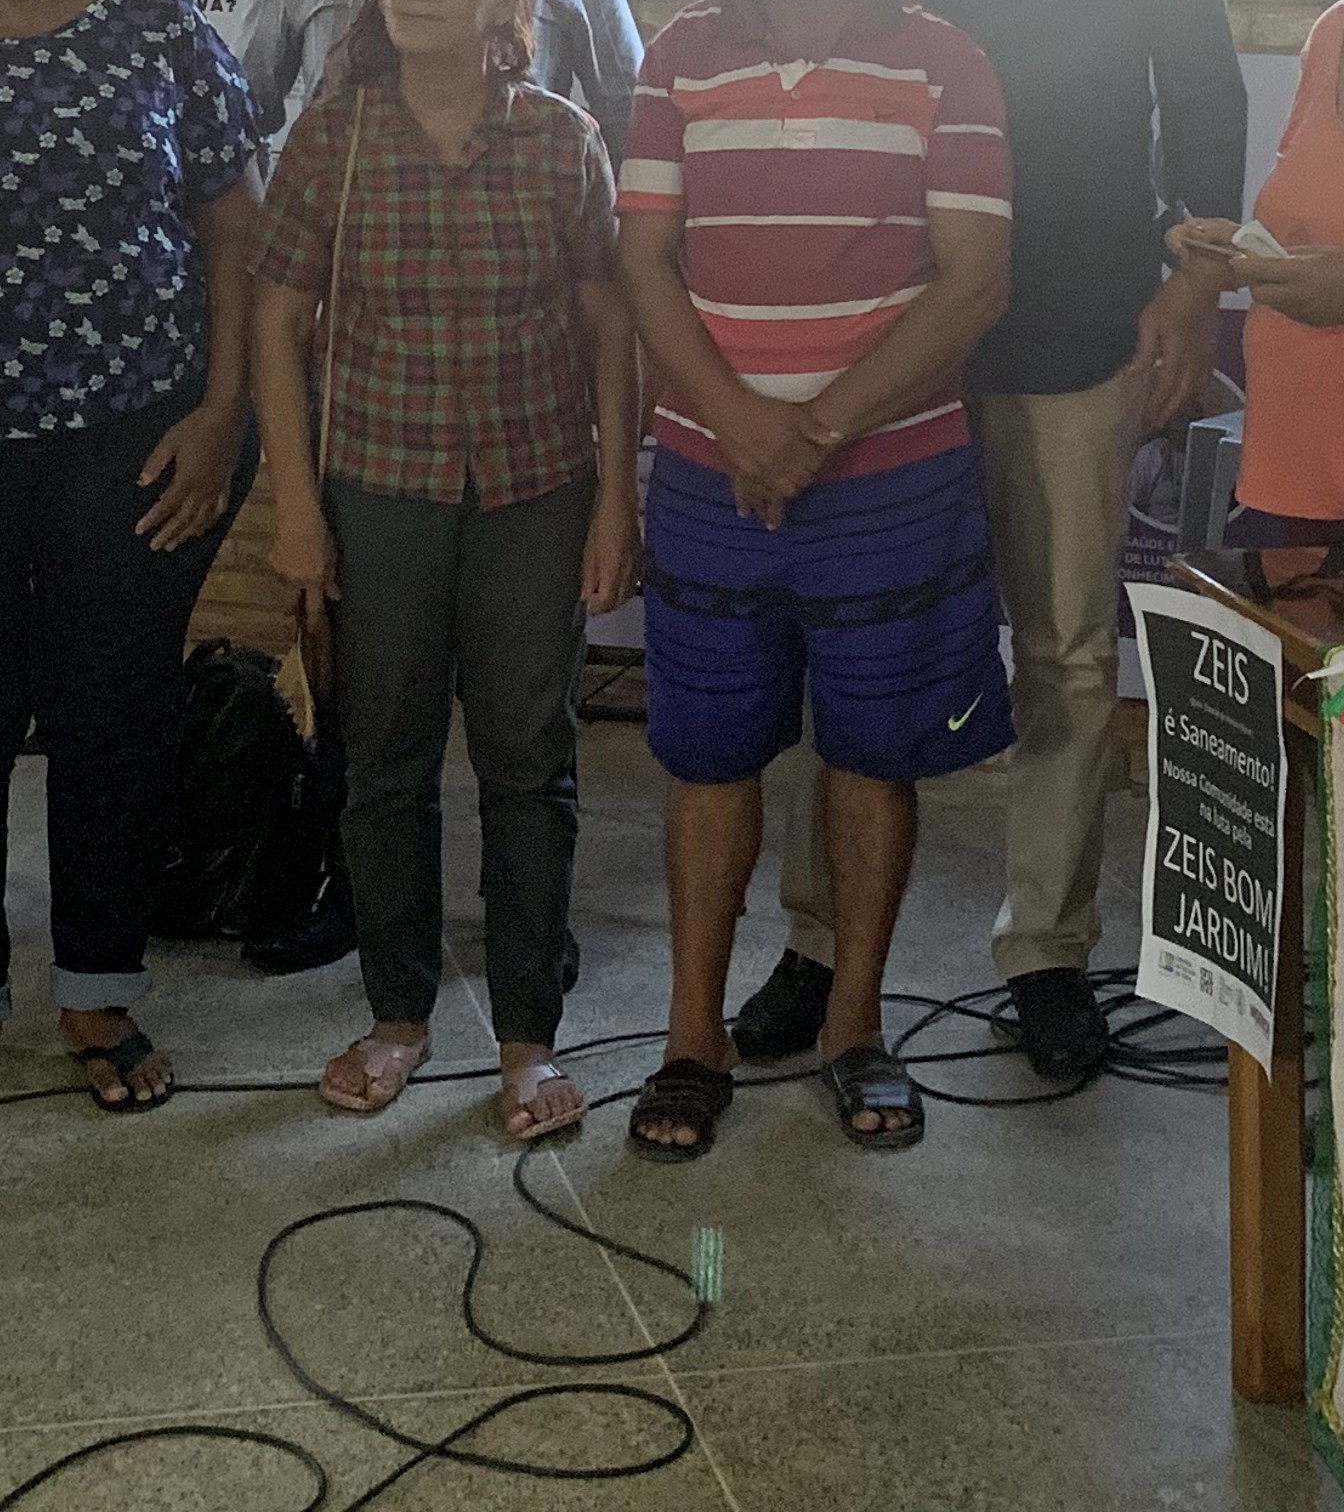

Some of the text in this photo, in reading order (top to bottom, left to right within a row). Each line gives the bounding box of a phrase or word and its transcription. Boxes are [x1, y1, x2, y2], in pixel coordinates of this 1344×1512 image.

[1190, 631, 1250, 705] ZEIS
[1162, 757, 1198, 787] Nossa
[1164, 707, 1176, 736] é
[1179, 714, 1276, 792] Saneamento!
[1162, 825, 1274, 935] ZEIS BOM
[1173, 892, 1270, 994] JARDIM!
